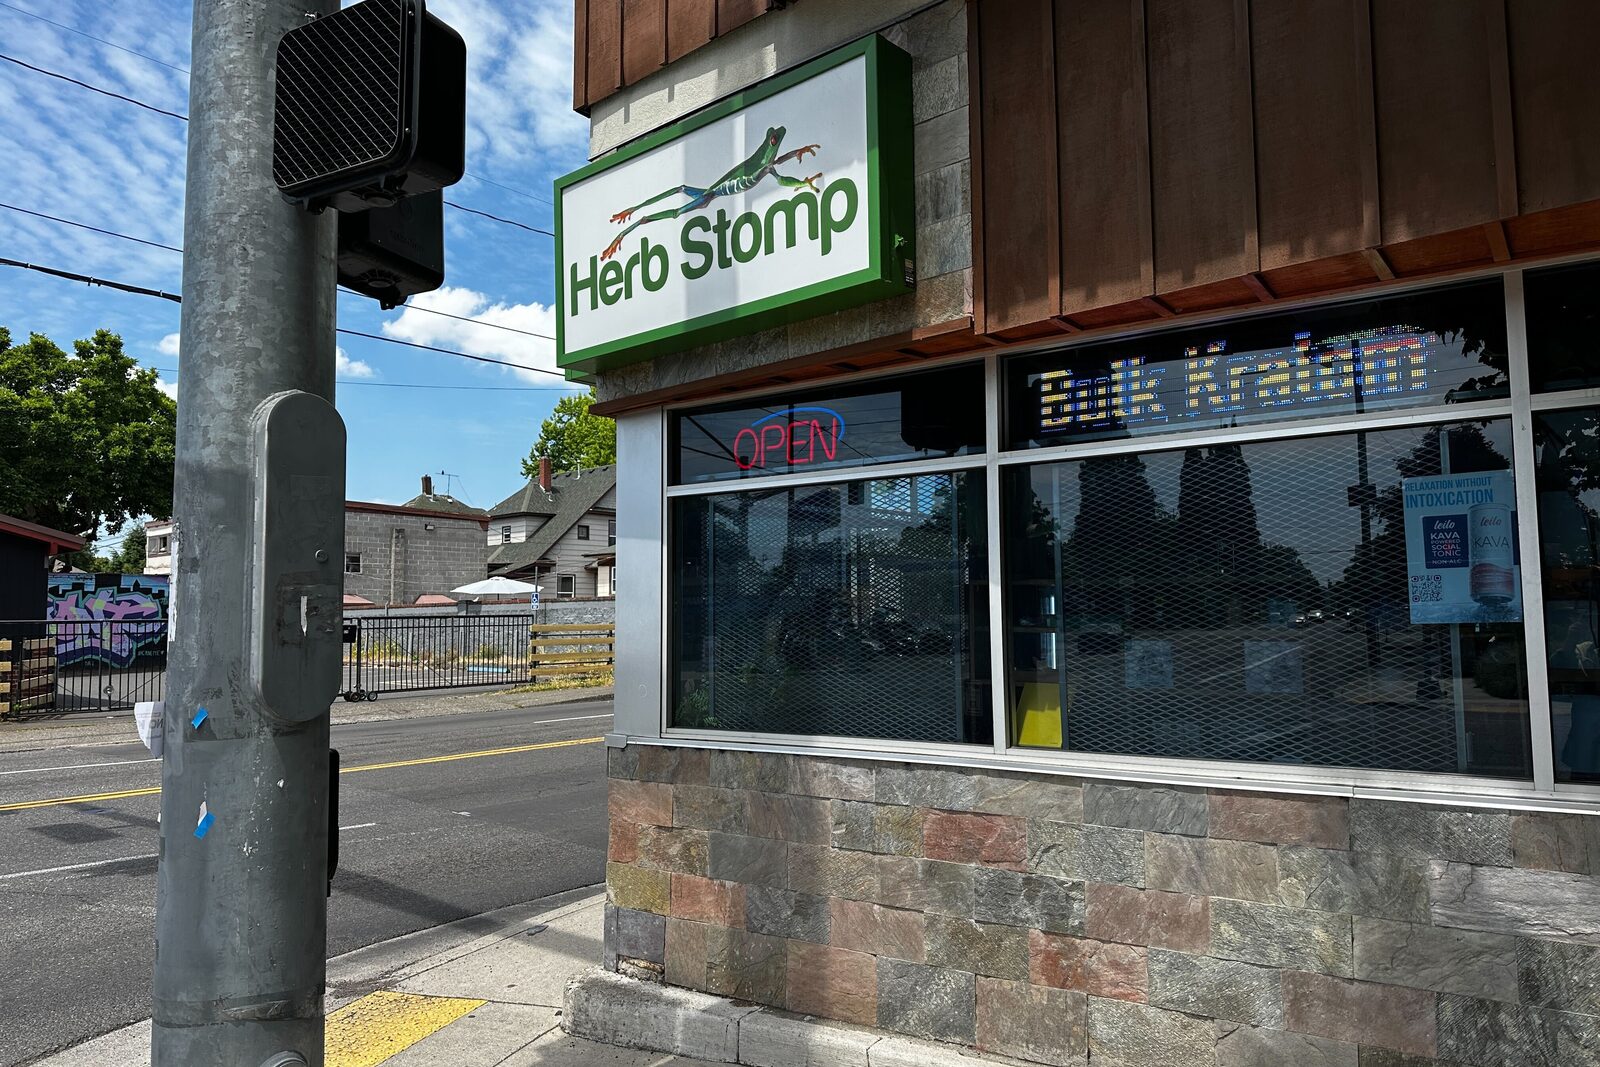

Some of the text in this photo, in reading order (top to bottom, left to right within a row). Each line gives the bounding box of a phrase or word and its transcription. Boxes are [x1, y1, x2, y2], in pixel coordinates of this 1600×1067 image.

[570, 177, 859, 317] Herb Stomp
[733, 417, 838, 469] OPEN
[1405, 476, 1493, 491] RELAXATION WITHOUT
[1405, 489, 1494, 508] INTOXICATION
[1434, 520, 1455, 530] leilo
[1475, 536, 1510, 548] KAVA
